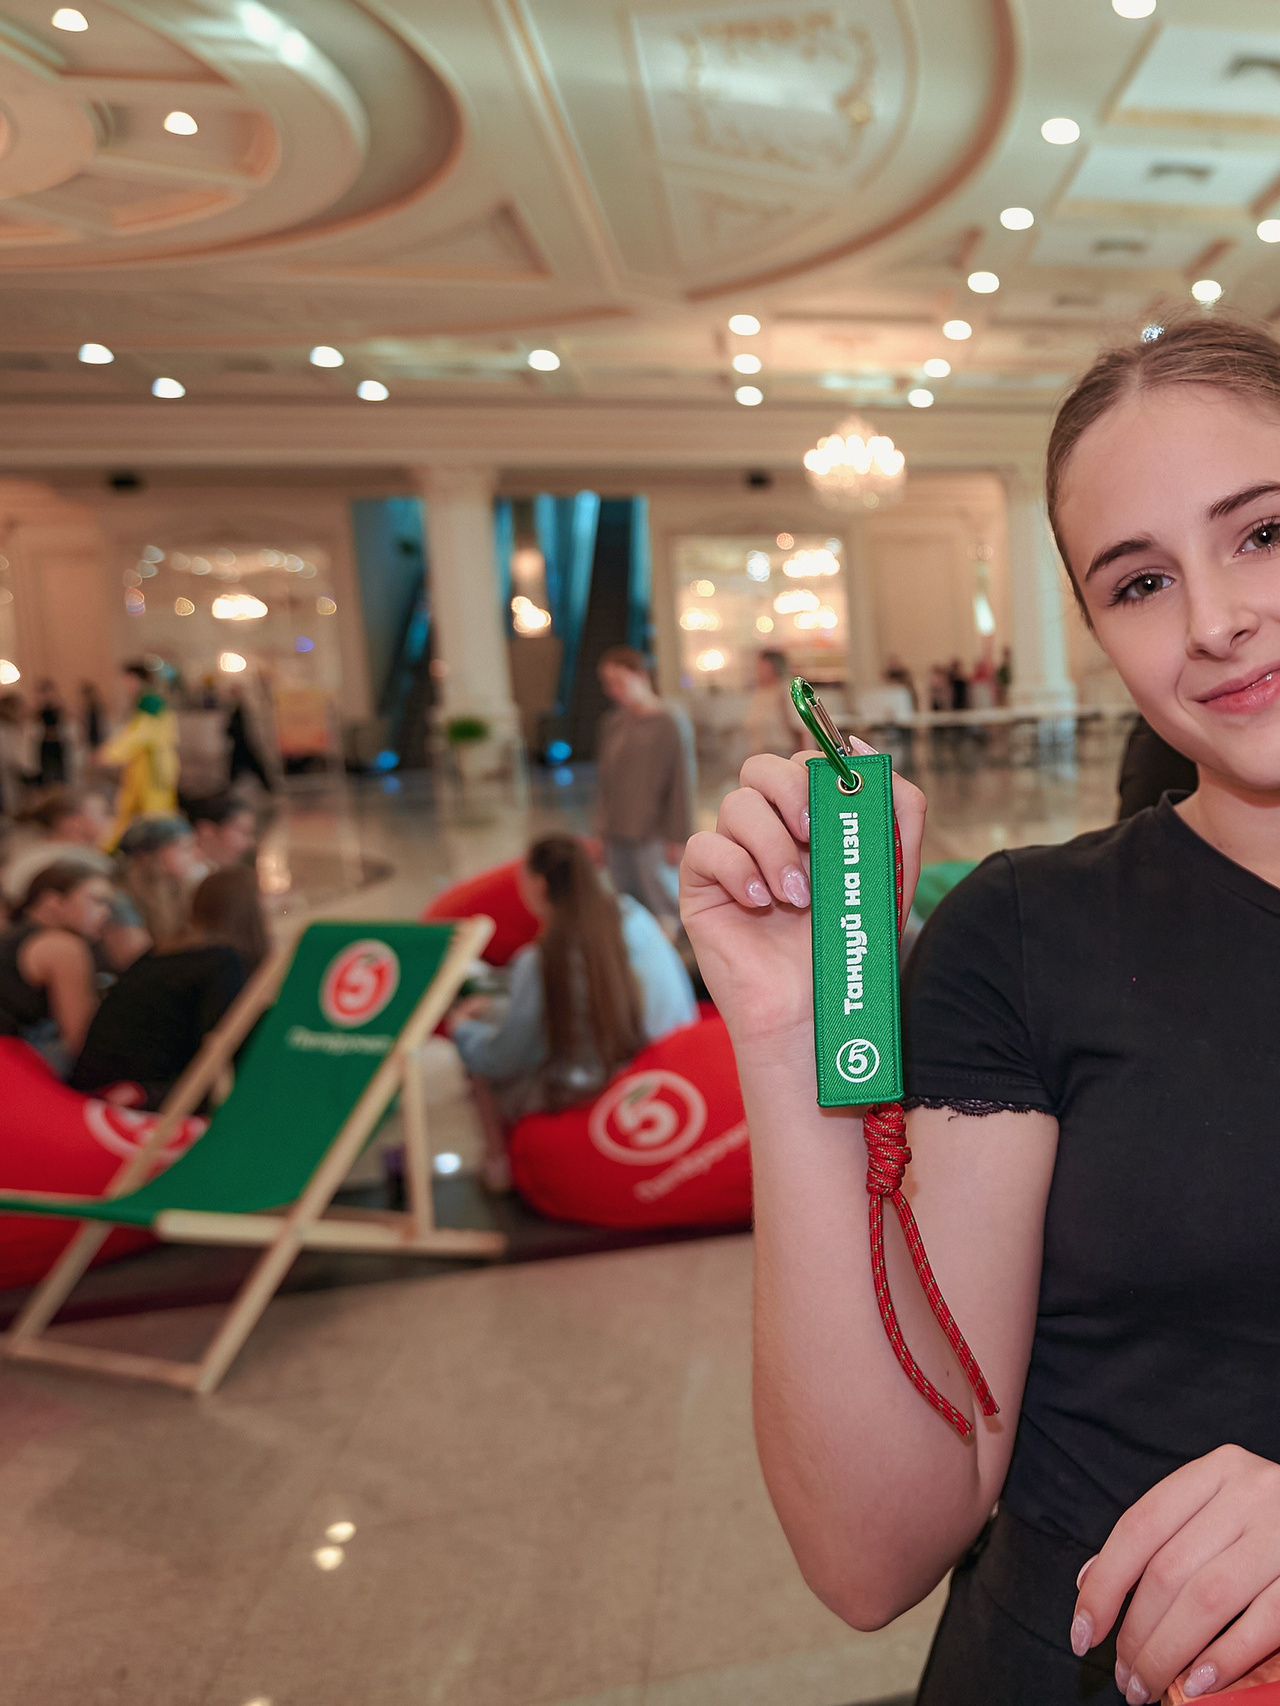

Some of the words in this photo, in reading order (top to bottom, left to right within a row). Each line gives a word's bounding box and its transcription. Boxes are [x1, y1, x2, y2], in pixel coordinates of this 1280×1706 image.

[839, 812, 860, 865] изи!
[844, 872, 861, 906] на
[840, 913, 868, 1016] Танцуй
